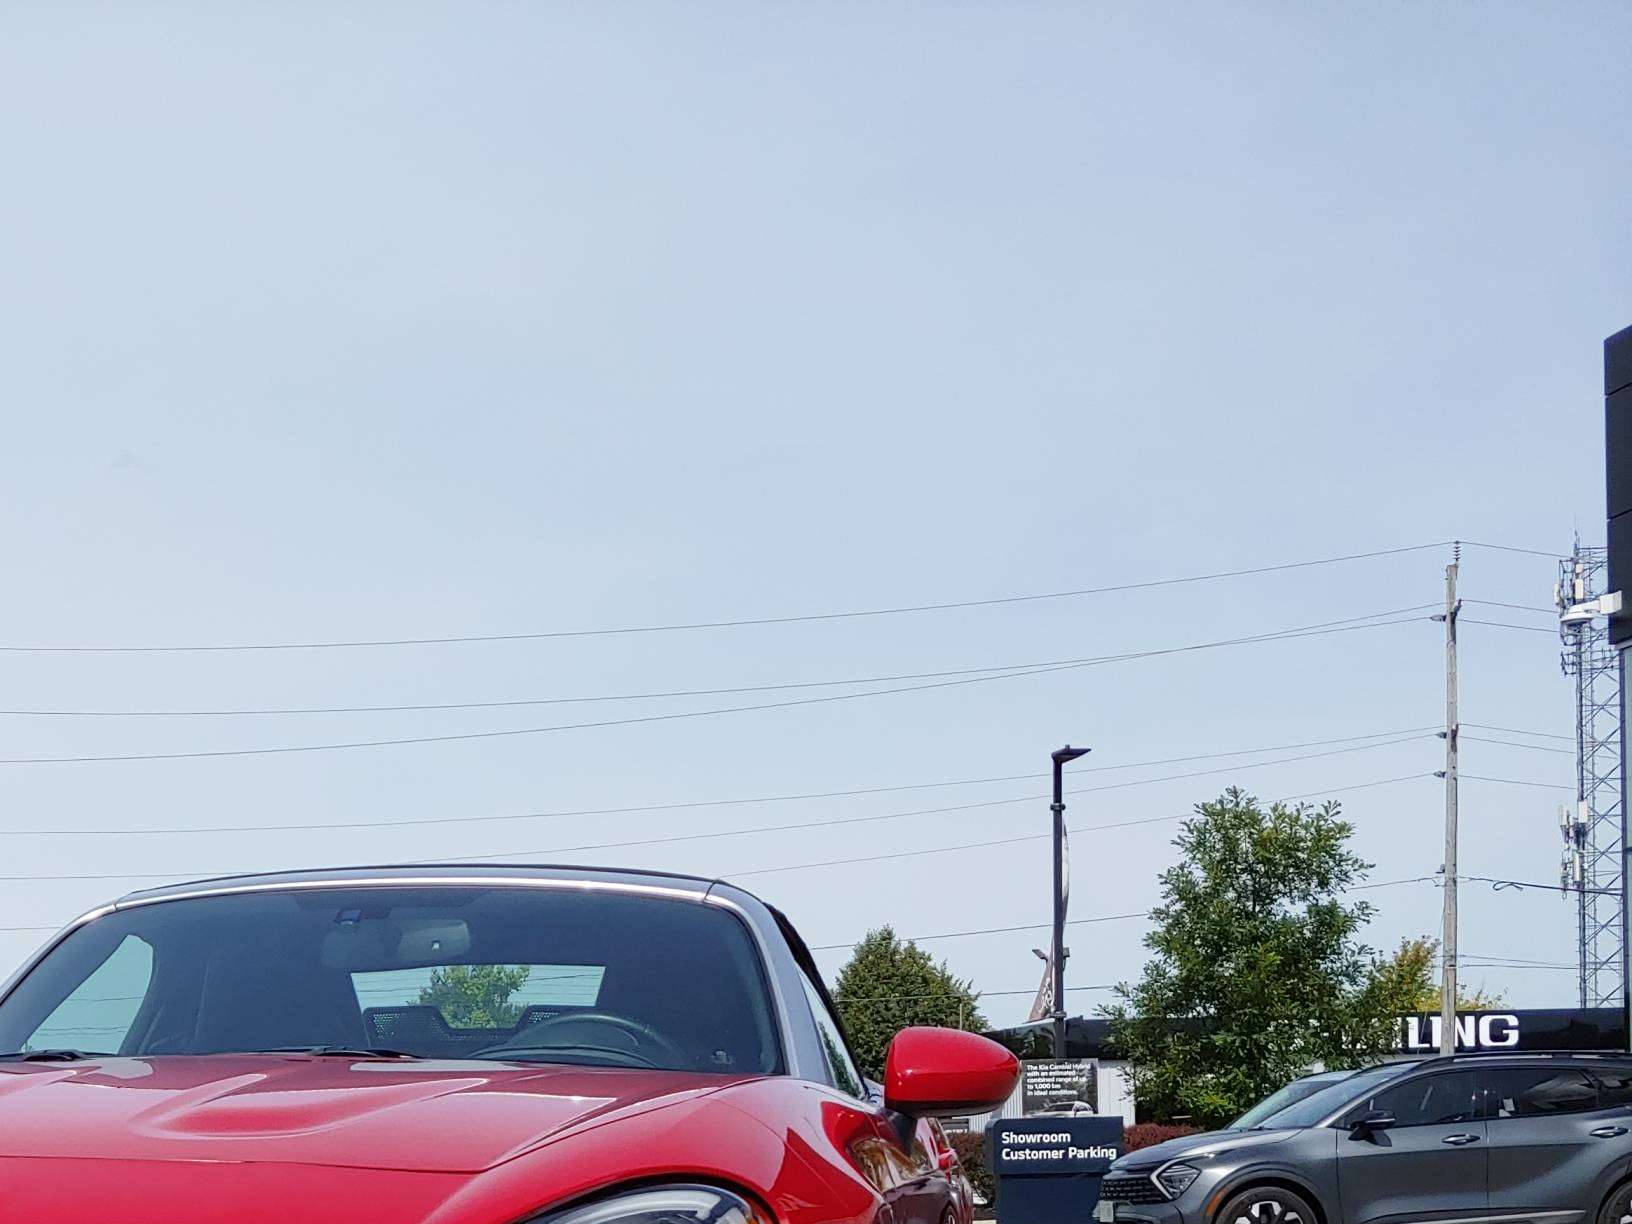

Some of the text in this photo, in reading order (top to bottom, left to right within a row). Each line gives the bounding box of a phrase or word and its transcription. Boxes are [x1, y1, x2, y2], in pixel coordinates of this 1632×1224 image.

[1001, 1131, 1071, 1144] Showroom
[1002, 1146, 1117, 1160] Customer Parking
